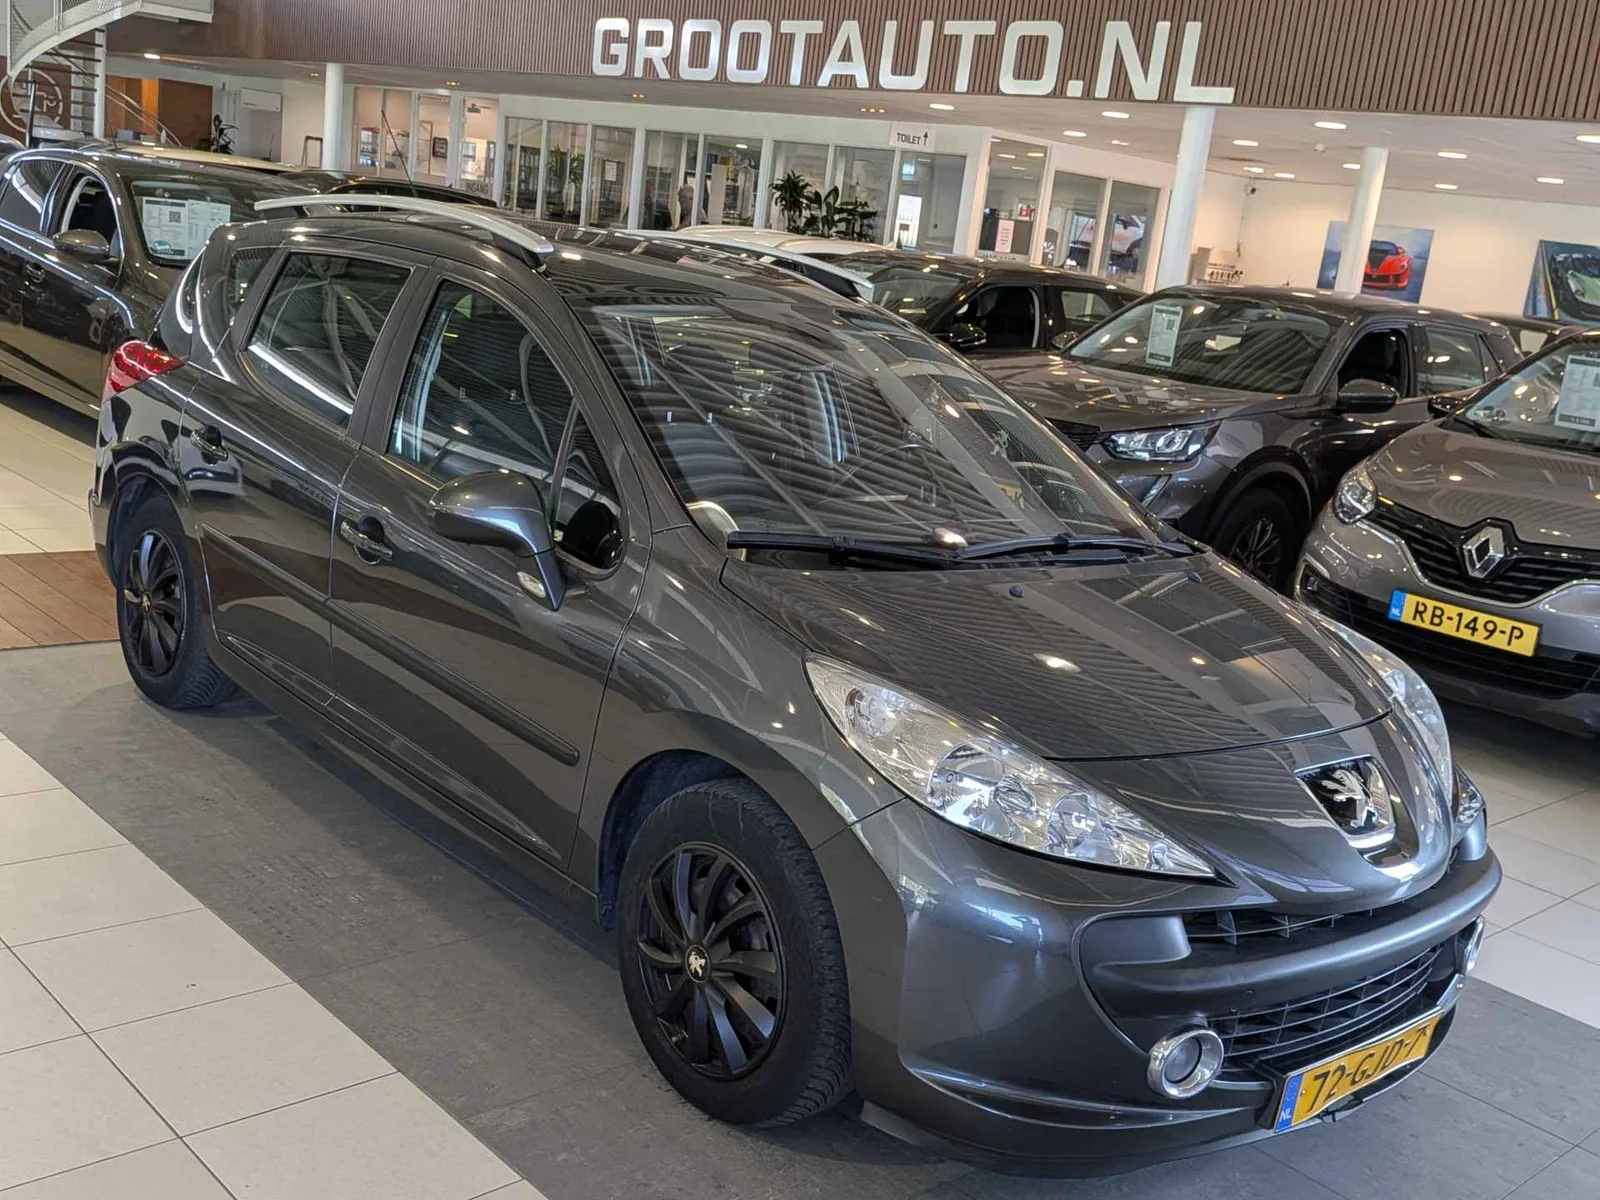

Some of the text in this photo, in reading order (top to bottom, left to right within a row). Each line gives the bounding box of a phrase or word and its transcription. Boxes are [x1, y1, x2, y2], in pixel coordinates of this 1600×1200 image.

[592, 17, 1235, 104] GROOTAUTO.NL
[896, 132, 921, 146] TOILET
[1391, 601, 1524, 646] NL RB-149-P
[1280, 1024, 1431, 1121] NL 72-GJD-7
